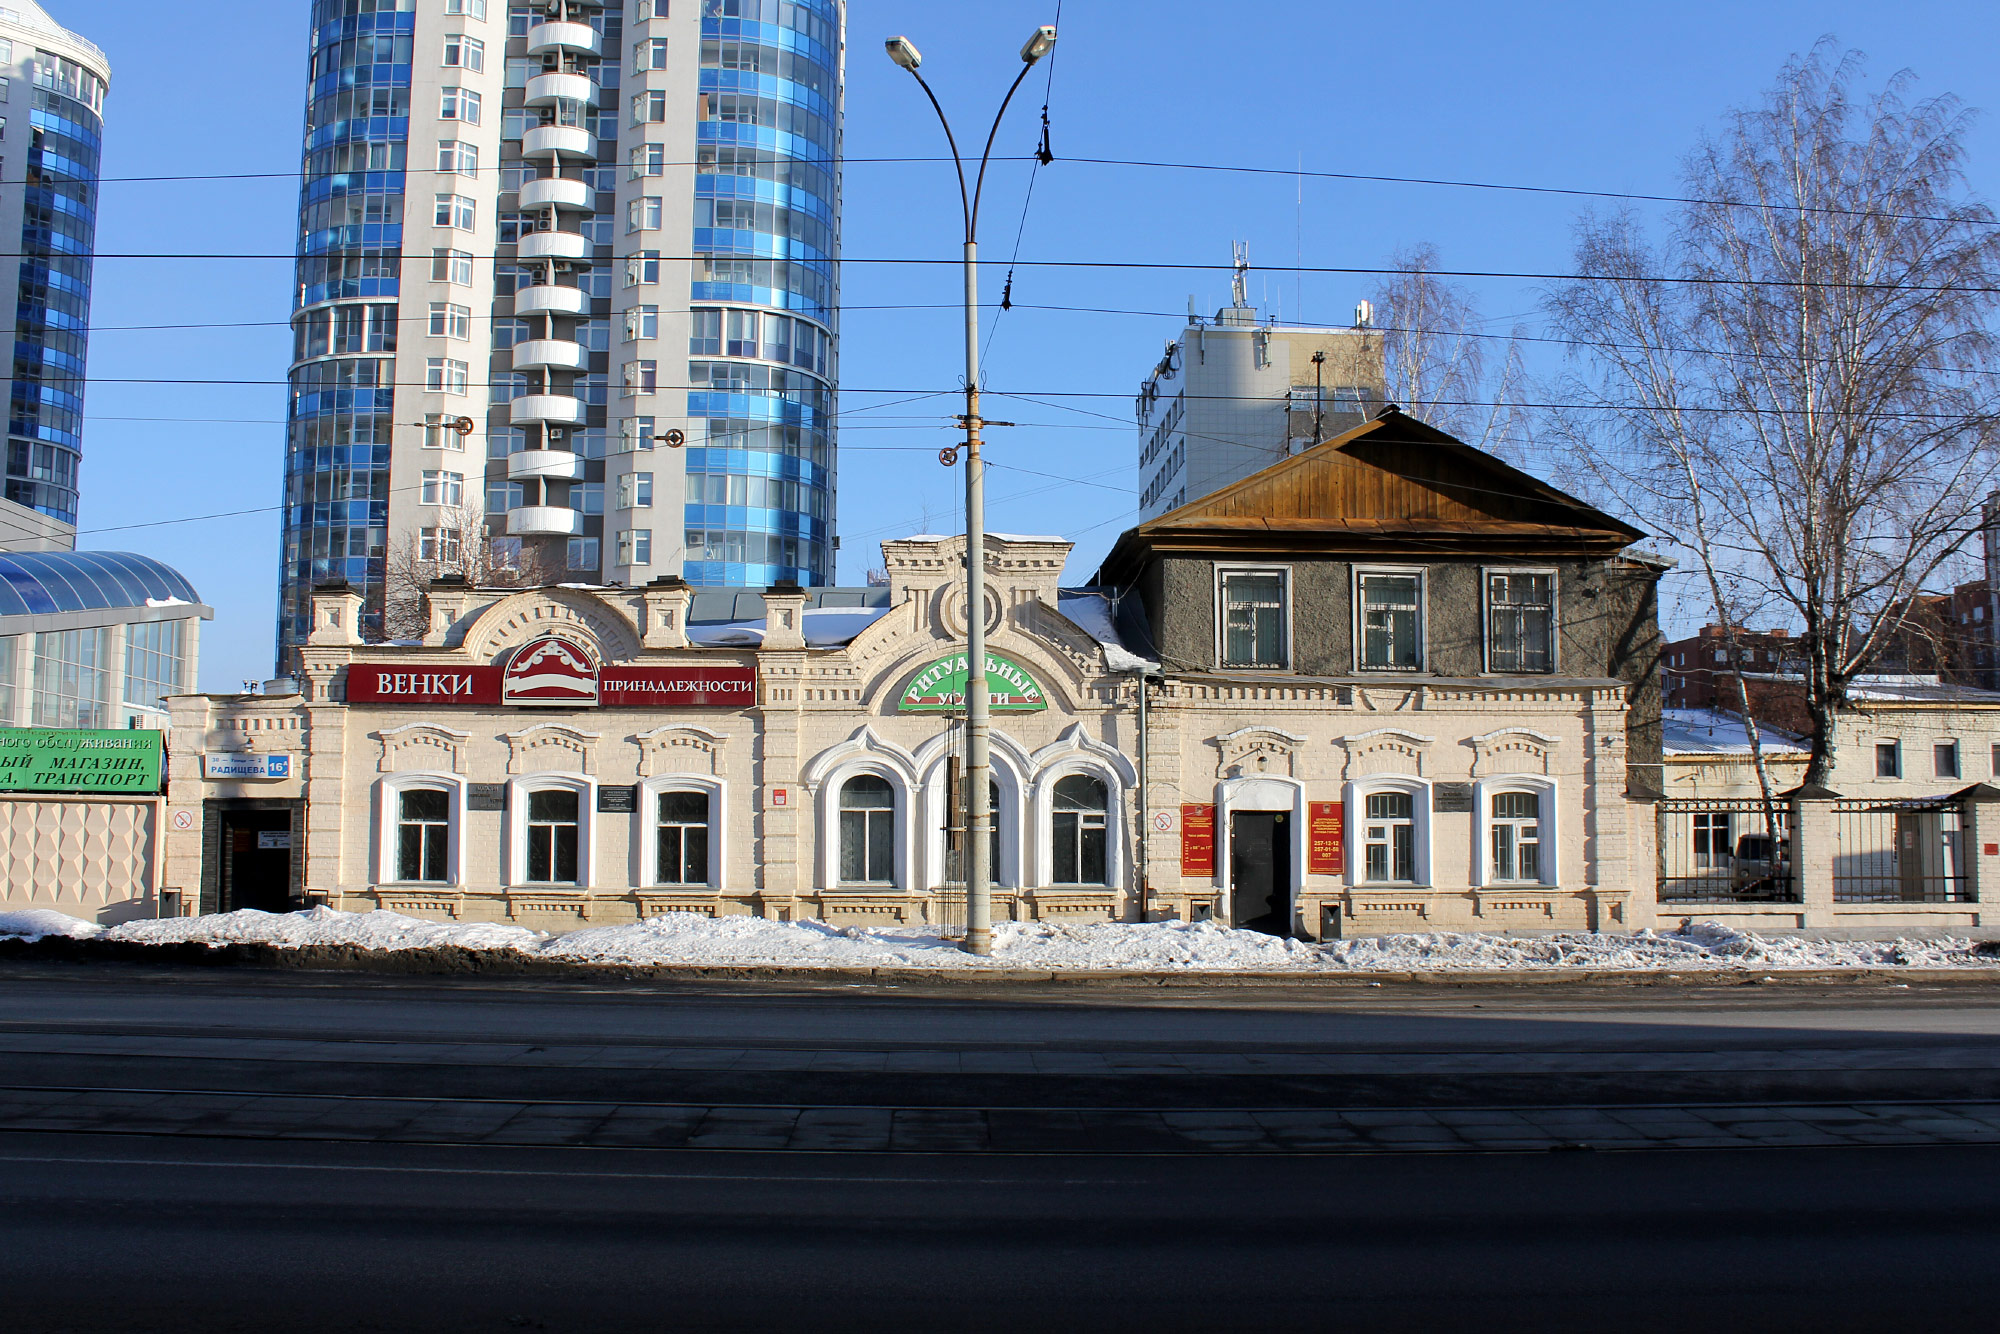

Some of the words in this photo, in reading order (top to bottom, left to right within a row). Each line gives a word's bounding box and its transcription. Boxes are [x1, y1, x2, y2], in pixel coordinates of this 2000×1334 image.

[376, 673, 473, 695] ВЕНКИ
[603, 680, 752, 693] ПРИНАДЛЕЖНОСТИ
[907, 656, 1039, 703] РИТУАЬНЫЕ
[936, 692, 1010, 705] УСГИ
[35, 735, 152, 752] обслуживания
[49, 757, 145, 771] МАГАЗИН,
[211, 766, 265, 775] РАДИЩЕВА
[33, 772, 149, 786] ТРАНСПОРТ
